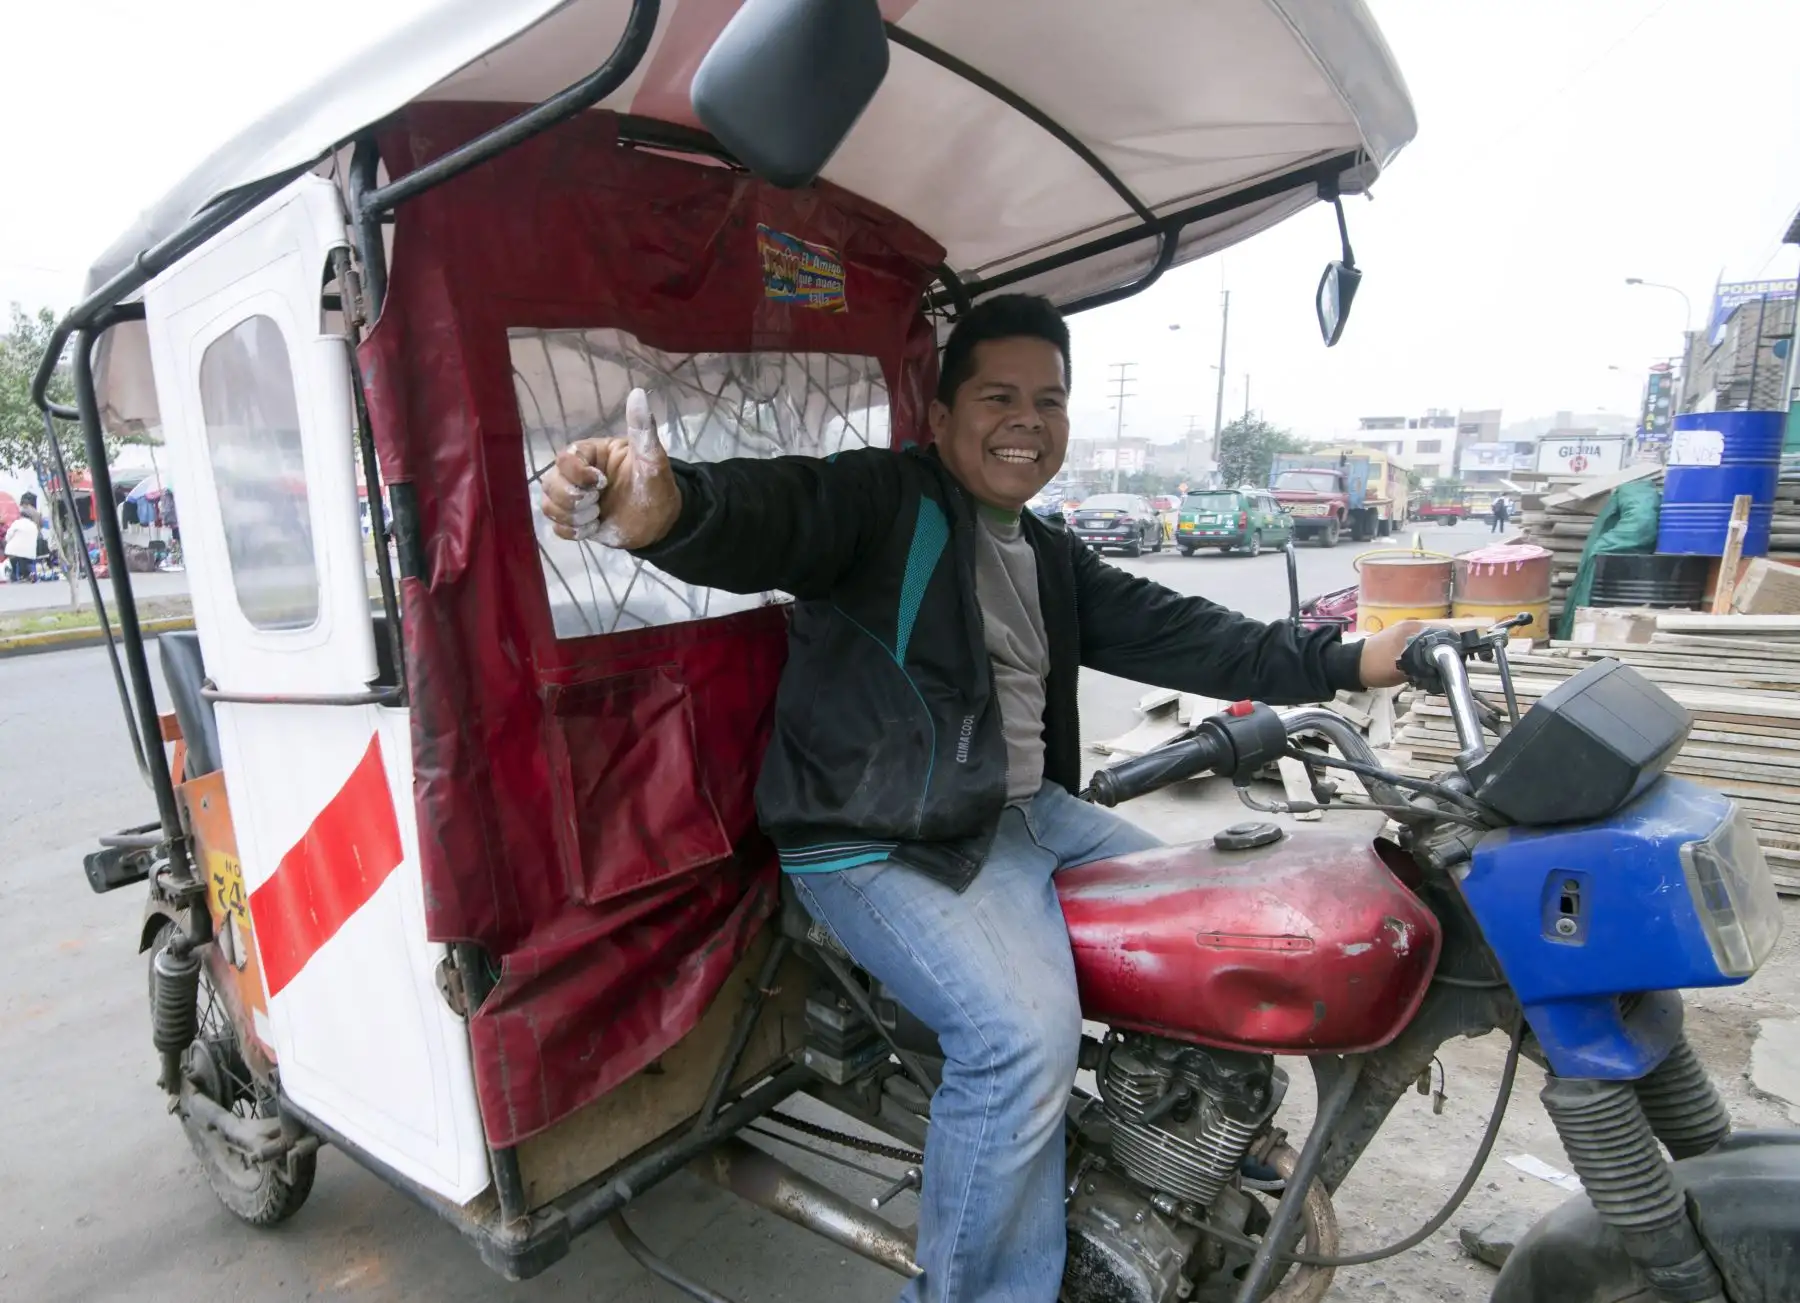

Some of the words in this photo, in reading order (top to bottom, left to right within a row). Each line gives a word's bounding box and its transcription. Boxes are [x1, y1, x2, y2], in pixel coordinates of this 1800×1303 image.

[813, 255, 841, 277] Amigo
[798, 273, 813, 289] que
[1558, 445, 1602, 458] GLORIA
[1675, 446, 1719, 464] VNDE
[213, 872, 247, 918] 74
